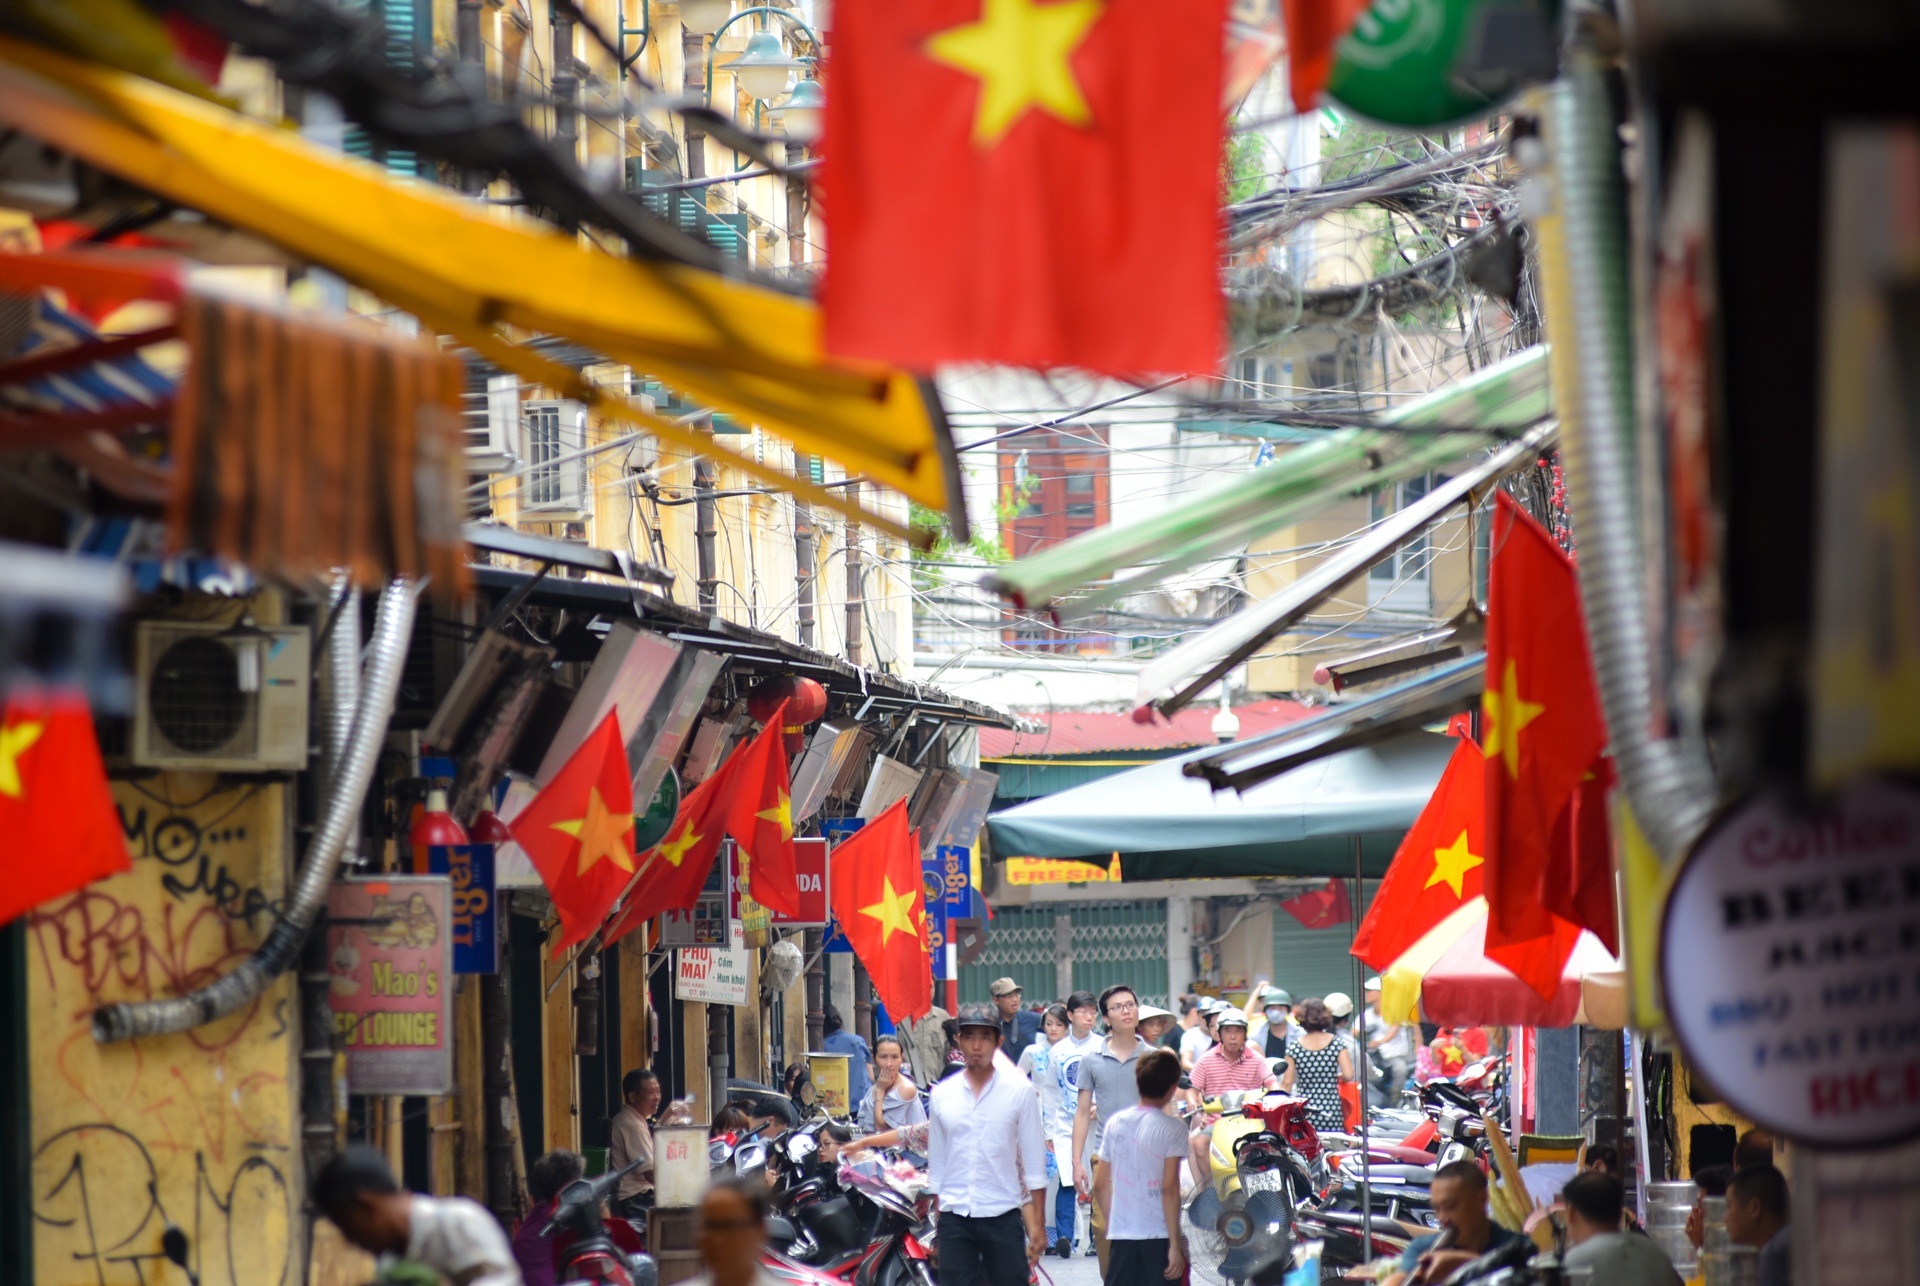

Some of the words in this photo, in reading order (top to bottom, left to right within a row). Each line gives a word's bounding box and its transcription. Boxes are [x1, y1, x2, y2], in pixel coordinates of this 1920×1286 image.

[1013, 869, 1102, 882] FRESH
[370, 959, 438, 998] Mao's
[681, 962, 706, 980] MAI
[716, 973, 730, 983] Hun
[363, 1012, 438, 1047] LOUNGE
